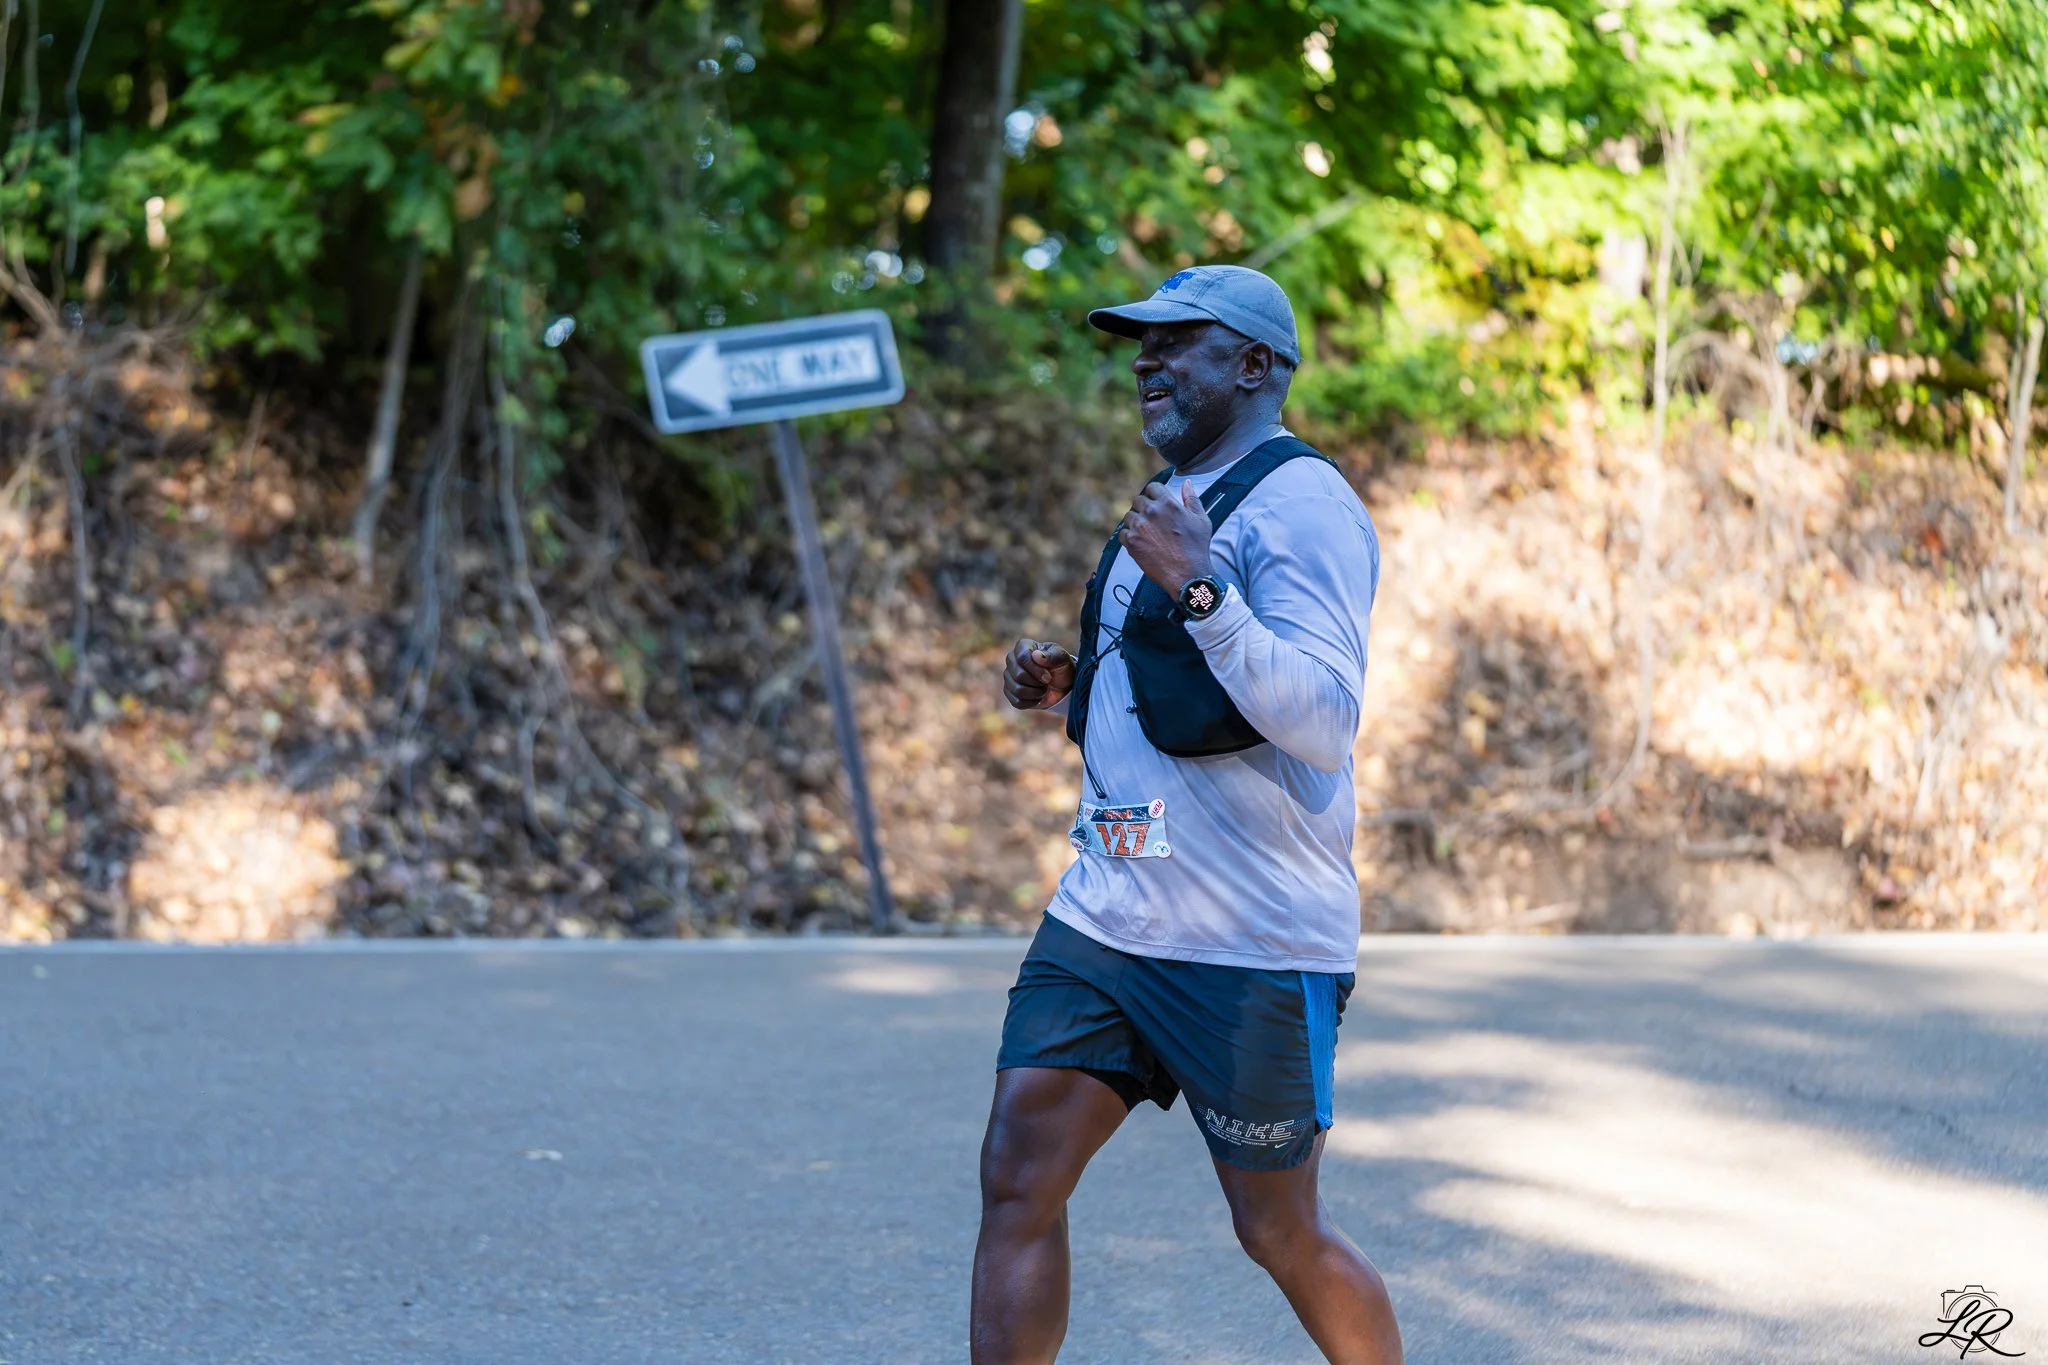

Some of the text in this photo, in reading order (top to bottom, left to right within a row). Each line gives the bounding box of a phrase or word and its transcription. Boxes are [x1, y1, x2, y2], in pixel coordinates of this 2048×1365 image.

[728, 340, 867, 390] ONE WAY
[1096, 822, 1151, 856] 127
[1206, 1108, 1295, 1139] NIKE
